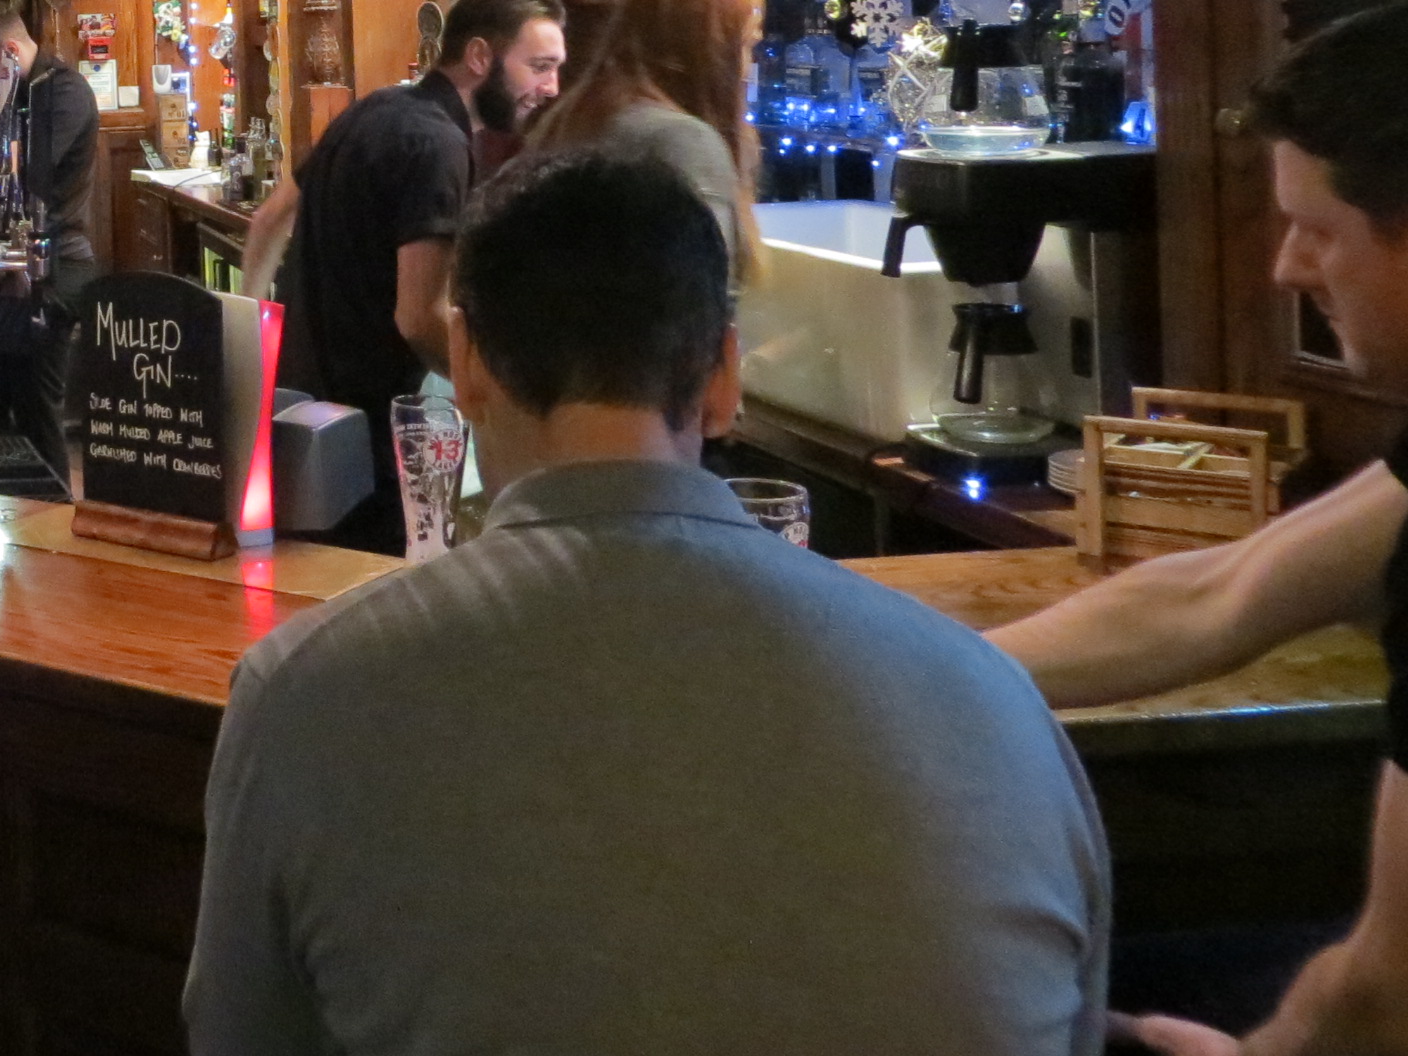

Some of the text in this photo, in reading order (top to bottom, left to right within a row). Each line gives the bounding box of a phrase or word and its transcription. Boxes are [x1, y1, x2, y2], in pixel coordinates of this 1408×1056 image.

[96, 301, 181, 361] MULLED
[119, 399, 137, 414] GIN
[144, 402, 173, 420] TOPPED
[180, 407, 203, 428] WITH
[90, 419, 214, 449] WARM MULLED APPLE JUICE
[90, 442, 223, 480] GARNISHED WITH CRANBERRIES
